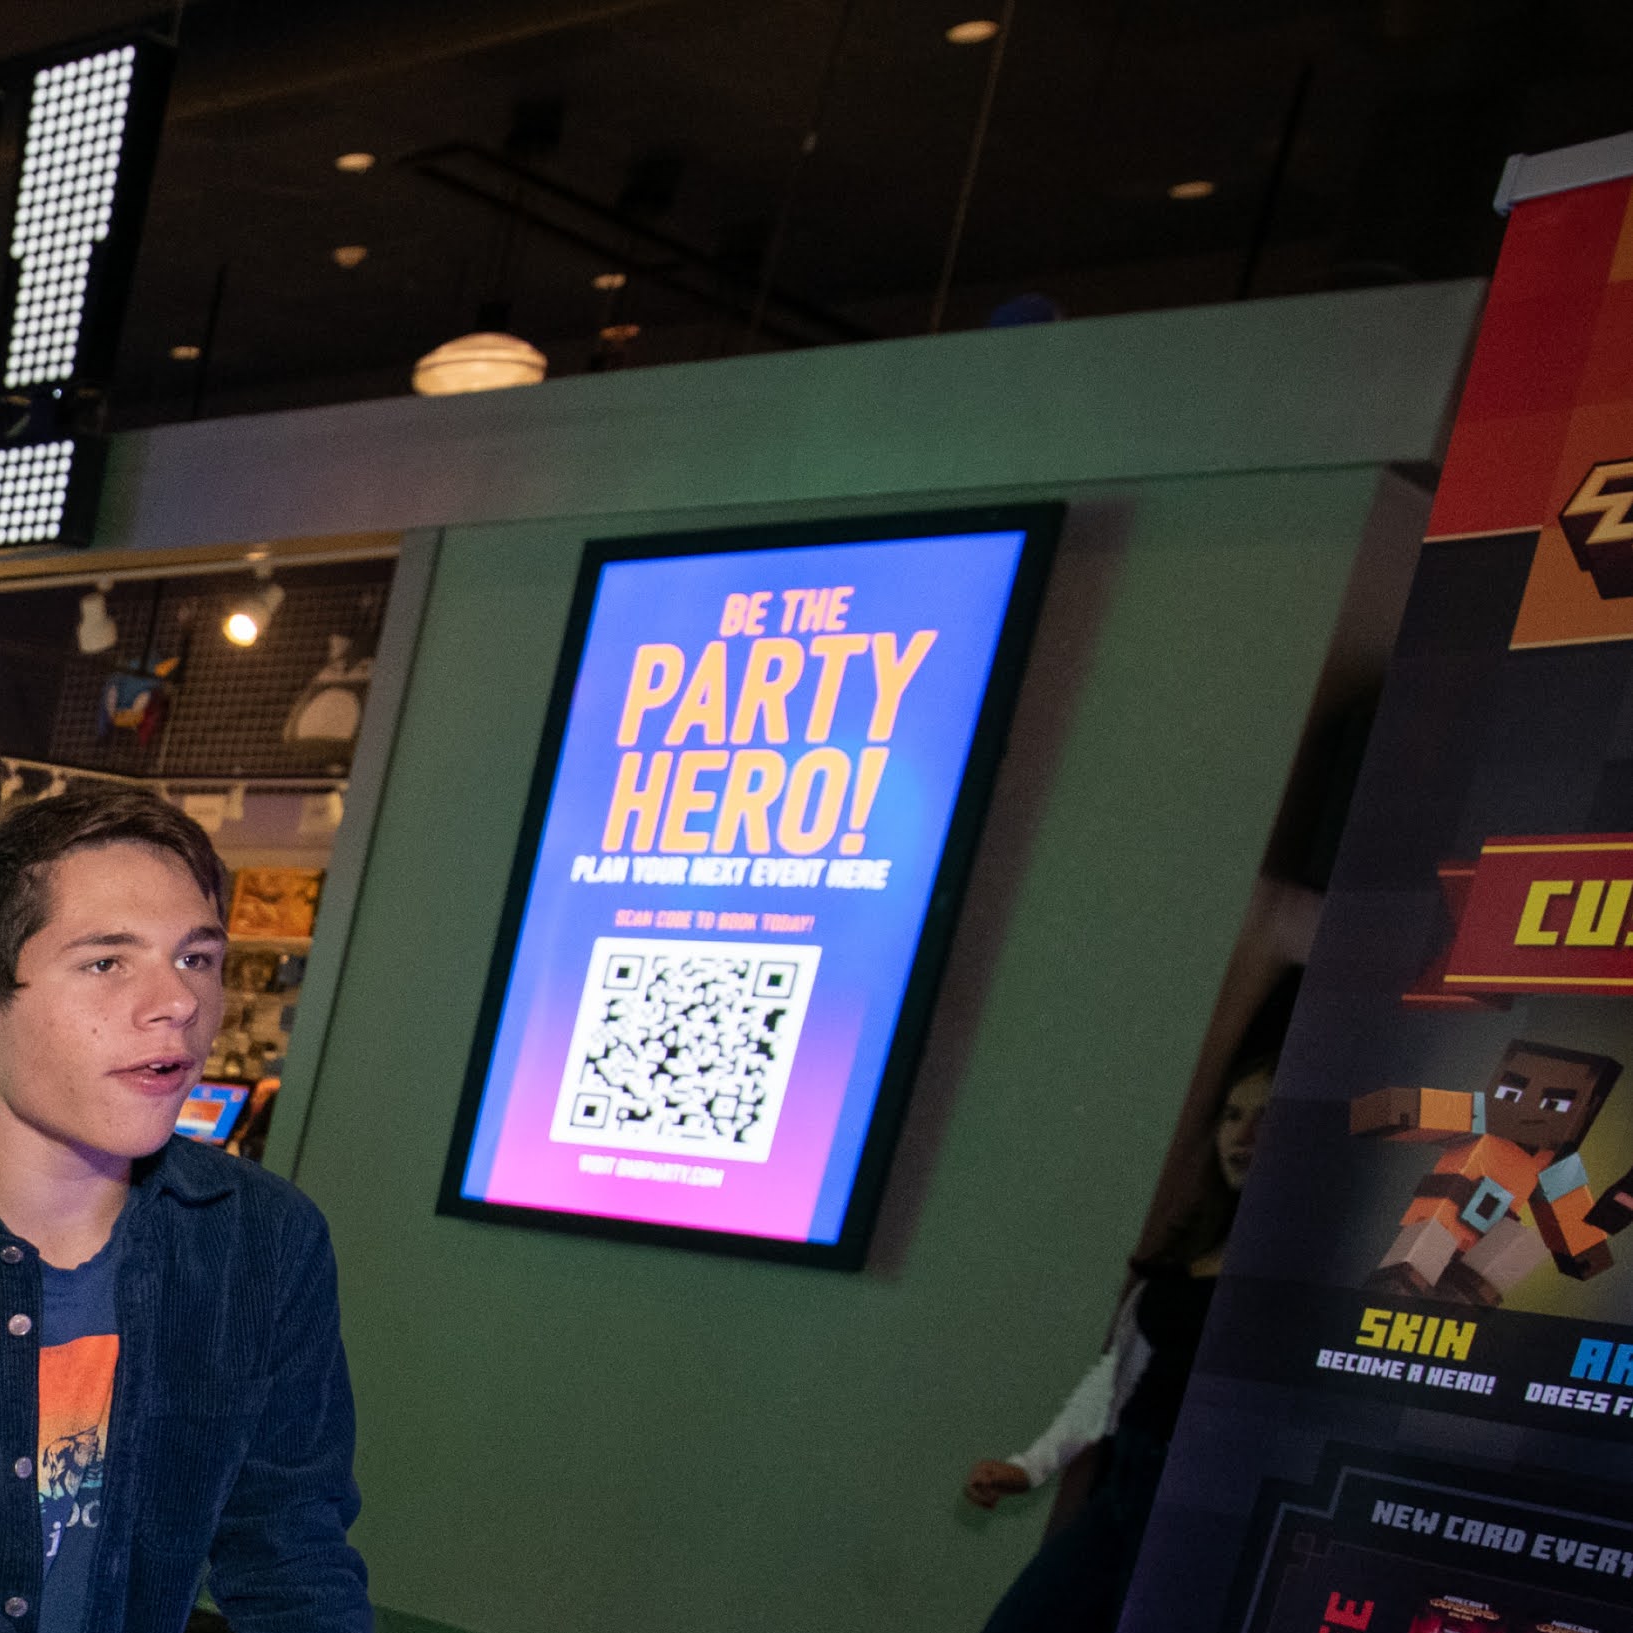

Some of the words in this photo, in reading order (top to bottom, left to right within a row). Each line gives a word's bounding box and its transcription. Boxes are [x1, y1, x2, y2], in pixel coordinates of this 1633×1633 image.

[720, 593, 767, 637] BE
[783, 586, 855, 634] THE
[615, 630, 939, 746] PARTY
[601, 747, 889, 854] HERO!
[570, 855, 630, 882] PLAN
[631, 856, 689, 885] YOUR
[688, 857, 751, 887] NEXT
[749, 858, 826, 888] EVENT
[825, 859, 892, 890] HERE
[696, 911, 715, 930] TO
[1514, 879, 1633, 946] CU
[1355, 1308, 1478, 1361] SKIN
[1316, 1347, 1403, 1381] BECOME
[1406, 1361, 1425, 1384] A
[1427, 1365, 1497, 1396] HERO!
[1525, 1380, 1612, 1417] DRESS
[1371, 1498, 1441, 1536] NEW
[1444, 1514, 1526, 1555] CARD
